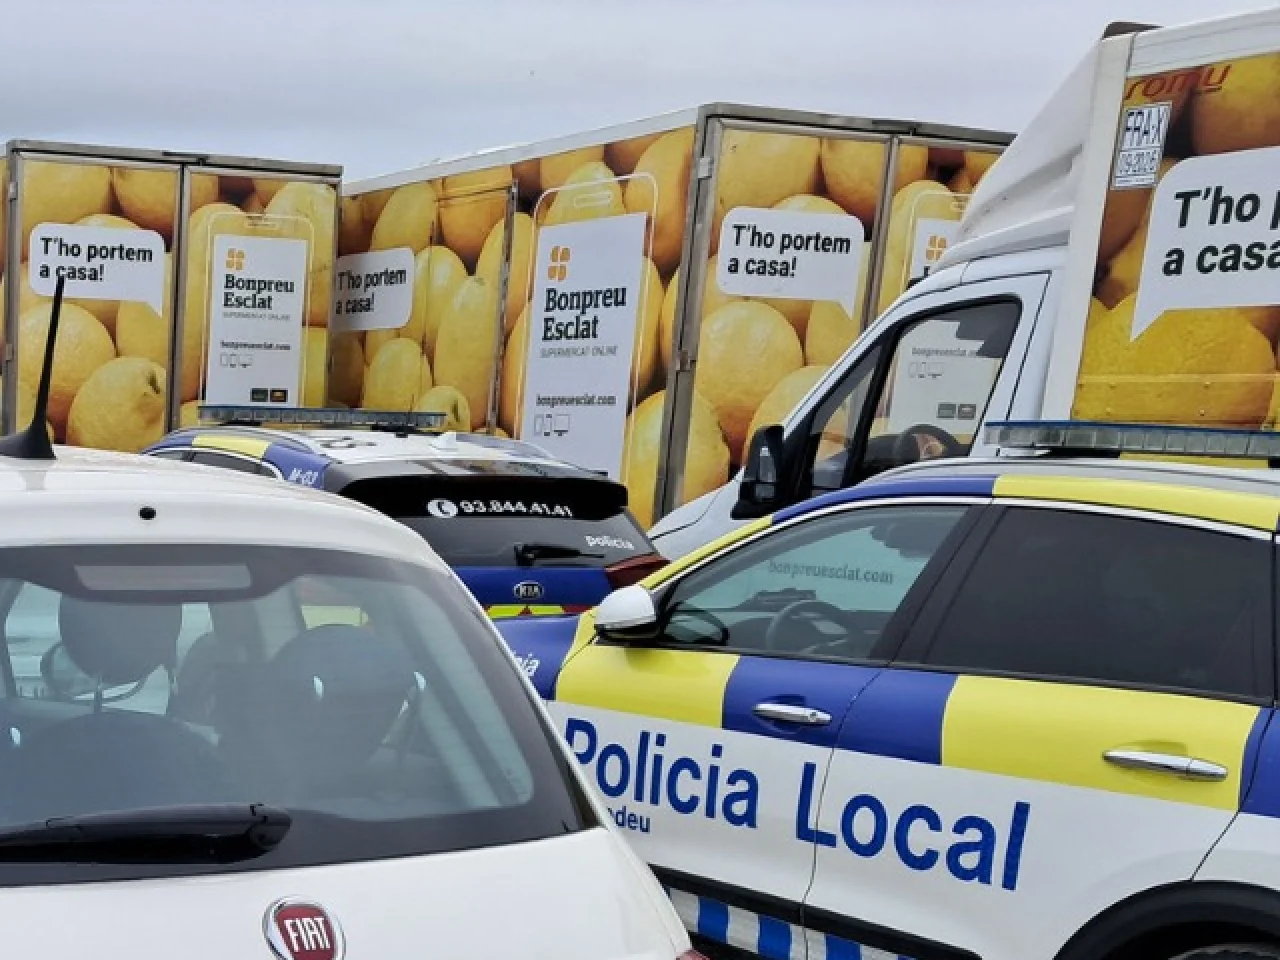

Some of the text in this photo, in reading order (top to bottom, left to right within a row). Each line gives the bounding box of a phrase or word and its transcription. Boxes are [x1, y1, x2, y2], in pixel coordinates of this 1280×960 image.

[1174, 185, 1261, 228] T'ho
[40, 236, 153, 263] T'ho portem
[732, 223, 851, 255] T'ho portem
[40, 263, 105, 282] a casa!
[728, 256, 797, 279] a casa!
[1162, 247, 1184, 276] a
[224, 273, 295, 295] Bonpreu
[364, 267, 407, 293] portem
[223, 291, 273, 310] Esclat
[345, 291, 375, 315] casa!
[544, 287, 627, 315] Bonpreu
[542, 315, 600, 342] Esclat
[583, 534, 635, 551] policia
[565, 717, 1031, 892] Policia Local
[283, 916, 331, 953] FIAT
